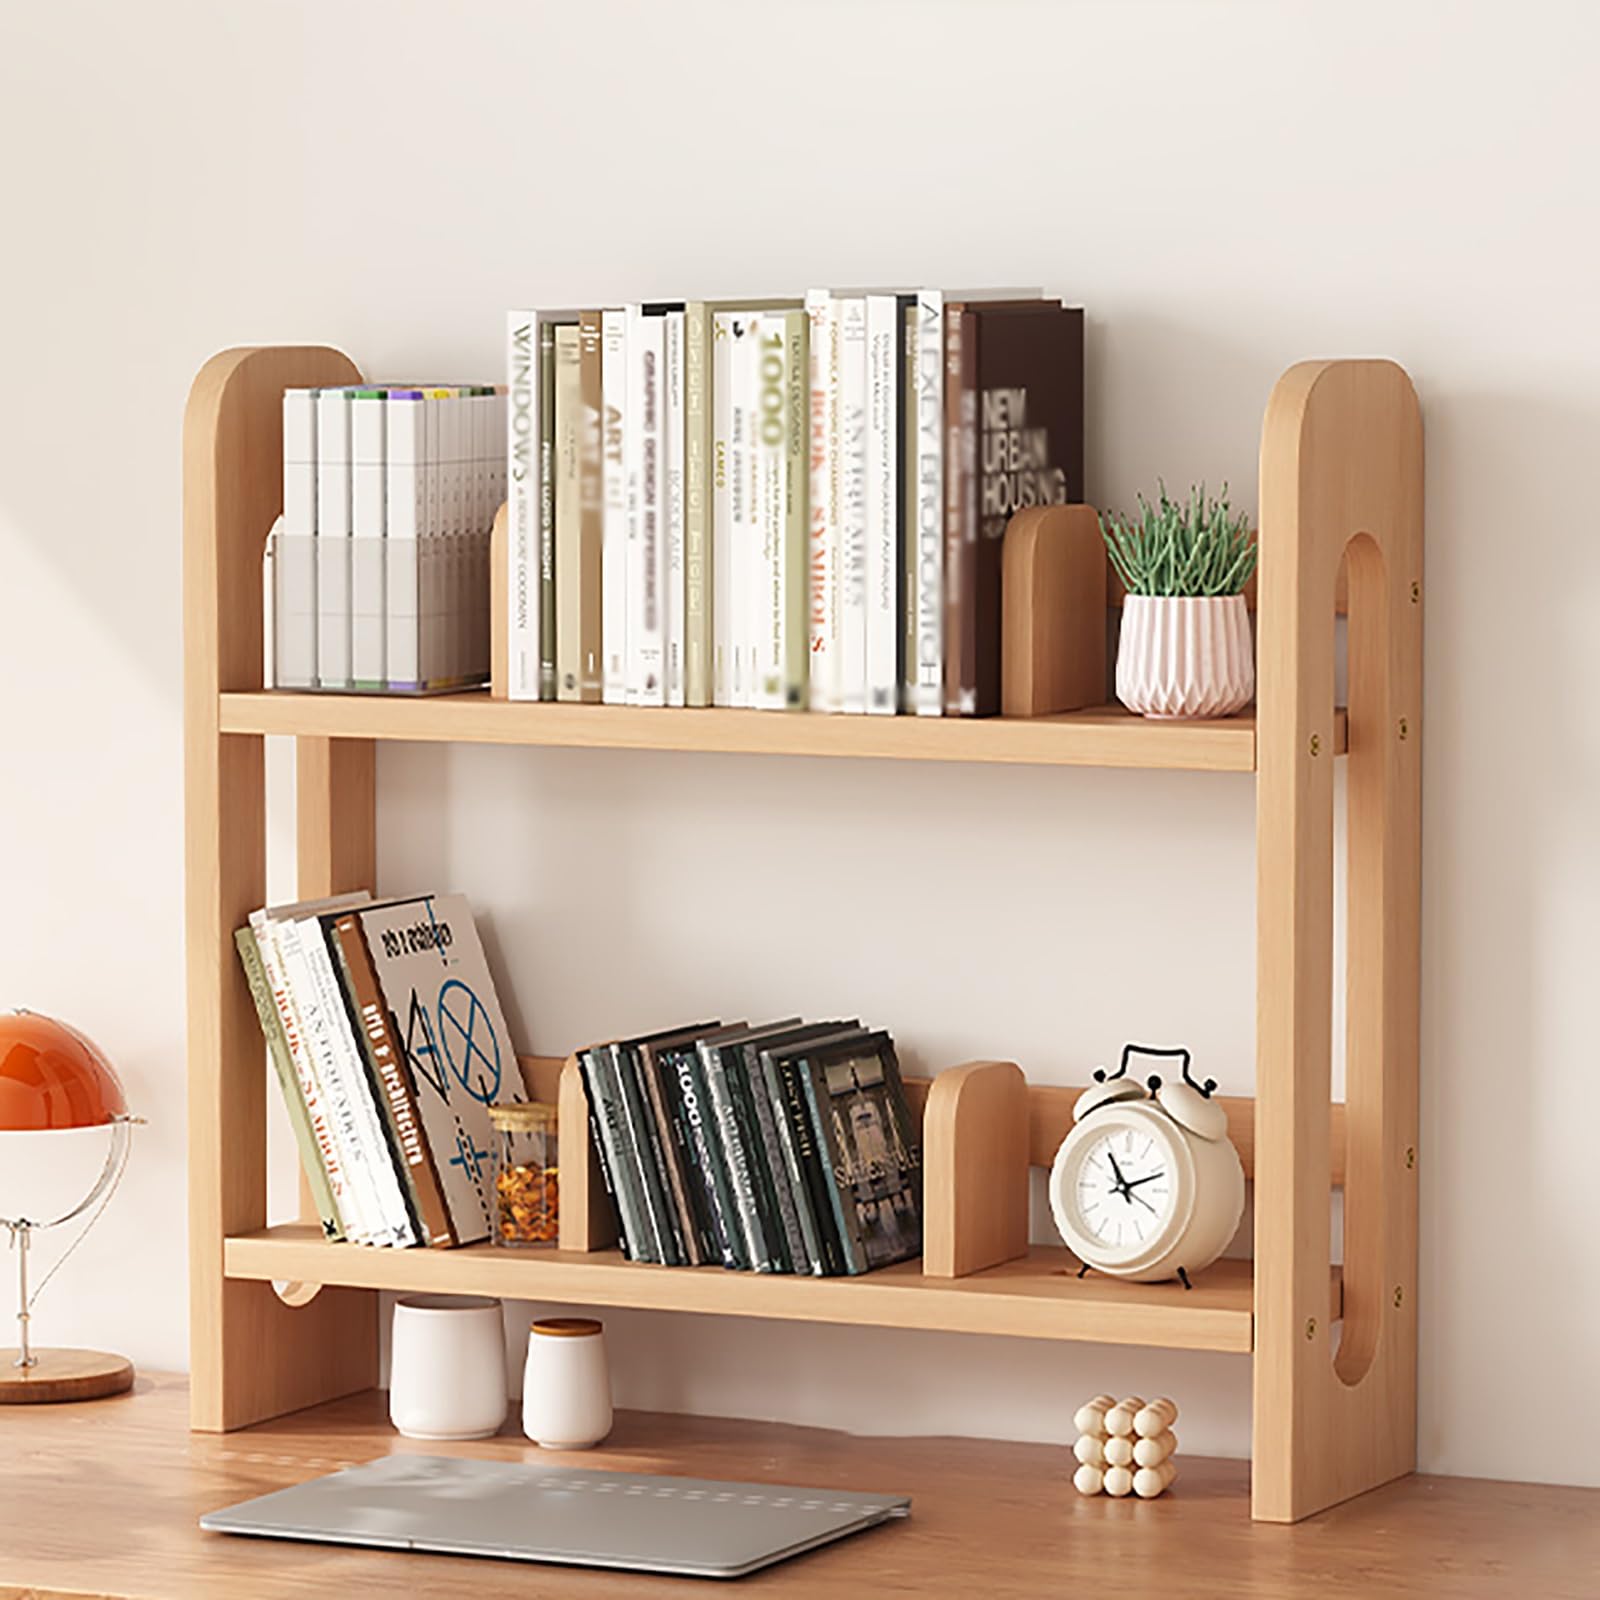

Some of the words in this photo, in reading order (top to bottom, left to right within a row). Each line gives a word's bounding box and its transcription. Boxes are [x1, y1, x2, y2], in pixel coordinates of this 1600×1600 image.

[512, 323, 532, 483] WINDOWS
[758, 332, 785, 447] 1000
[919, 302, 940, 437] ALEXEY
[982, 388, 1026, 429] NEW
[982, 427, 1048, 473] URBAN
[982, 467, 1067, 516] HOUSING
[810, 507, 826, 653] SYMBOLS
[919, 452, 940, 688] BRODOVITCH
[302, 1080, 343, 1197] SYMBOLS
